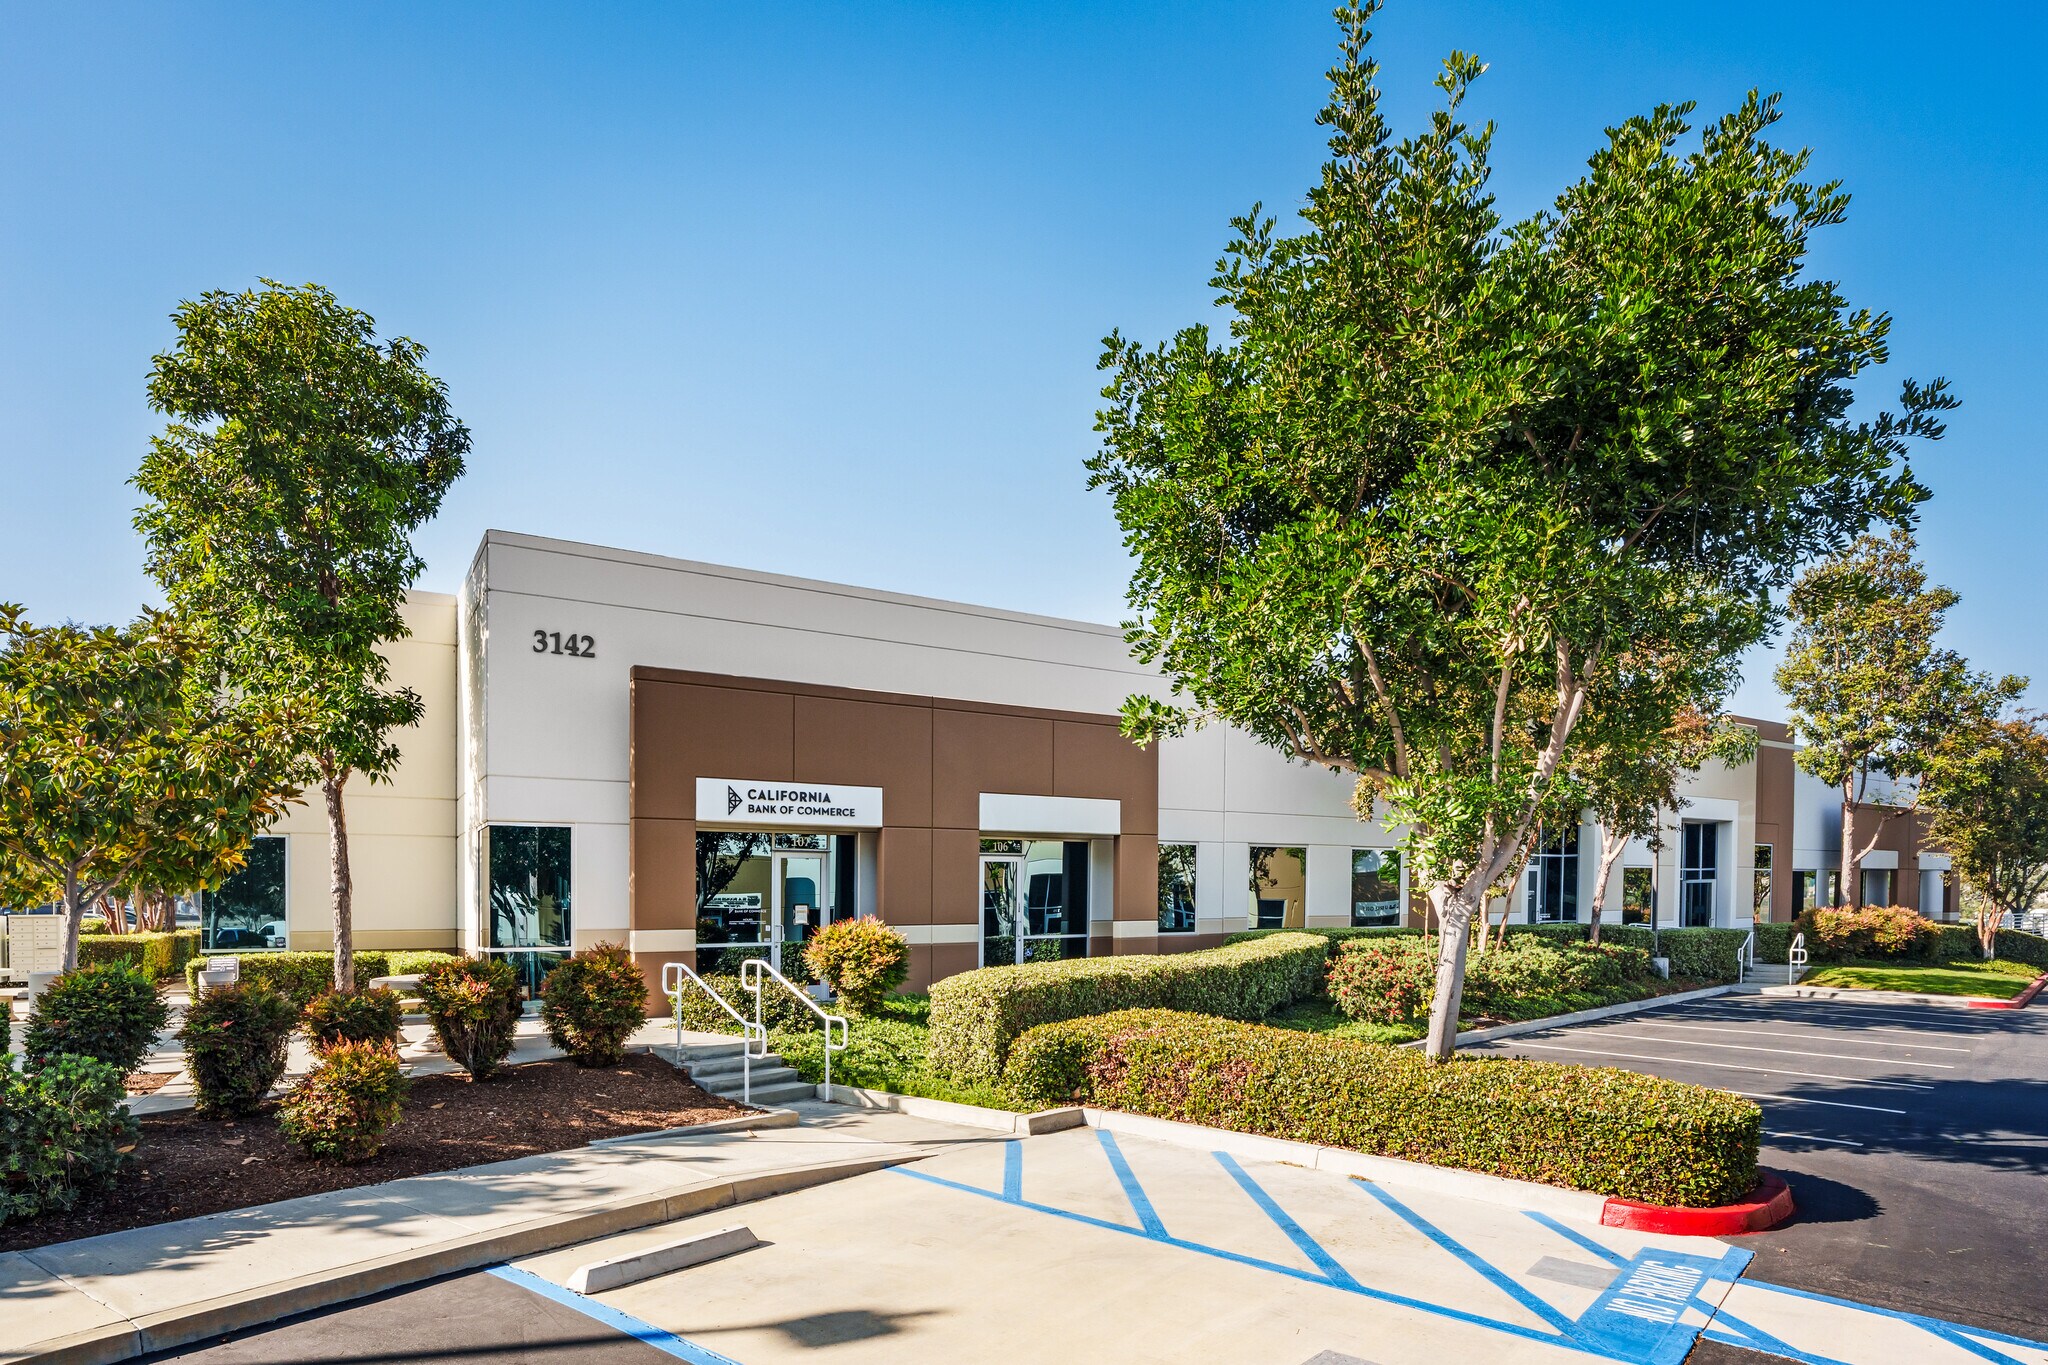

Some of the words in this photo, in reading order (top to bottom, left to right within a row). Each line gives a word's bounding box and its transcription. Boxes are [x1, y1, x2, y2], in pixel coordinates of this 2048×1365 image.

[533, 629, 595, 658] 3142
[748, 789, 831, 803] CALIFORNIA
[748, 804, 776, 814] BANK
[780, 805, 794, 815] OF
[797, 806, 855, 817] COMMERCE
[791, 836, 810, 847] 107
[992, 841, 1008, 852] 106
[1619, 1260, 1703, 1305] PARKING
[1604, 1298, 1677, 1324] NO
